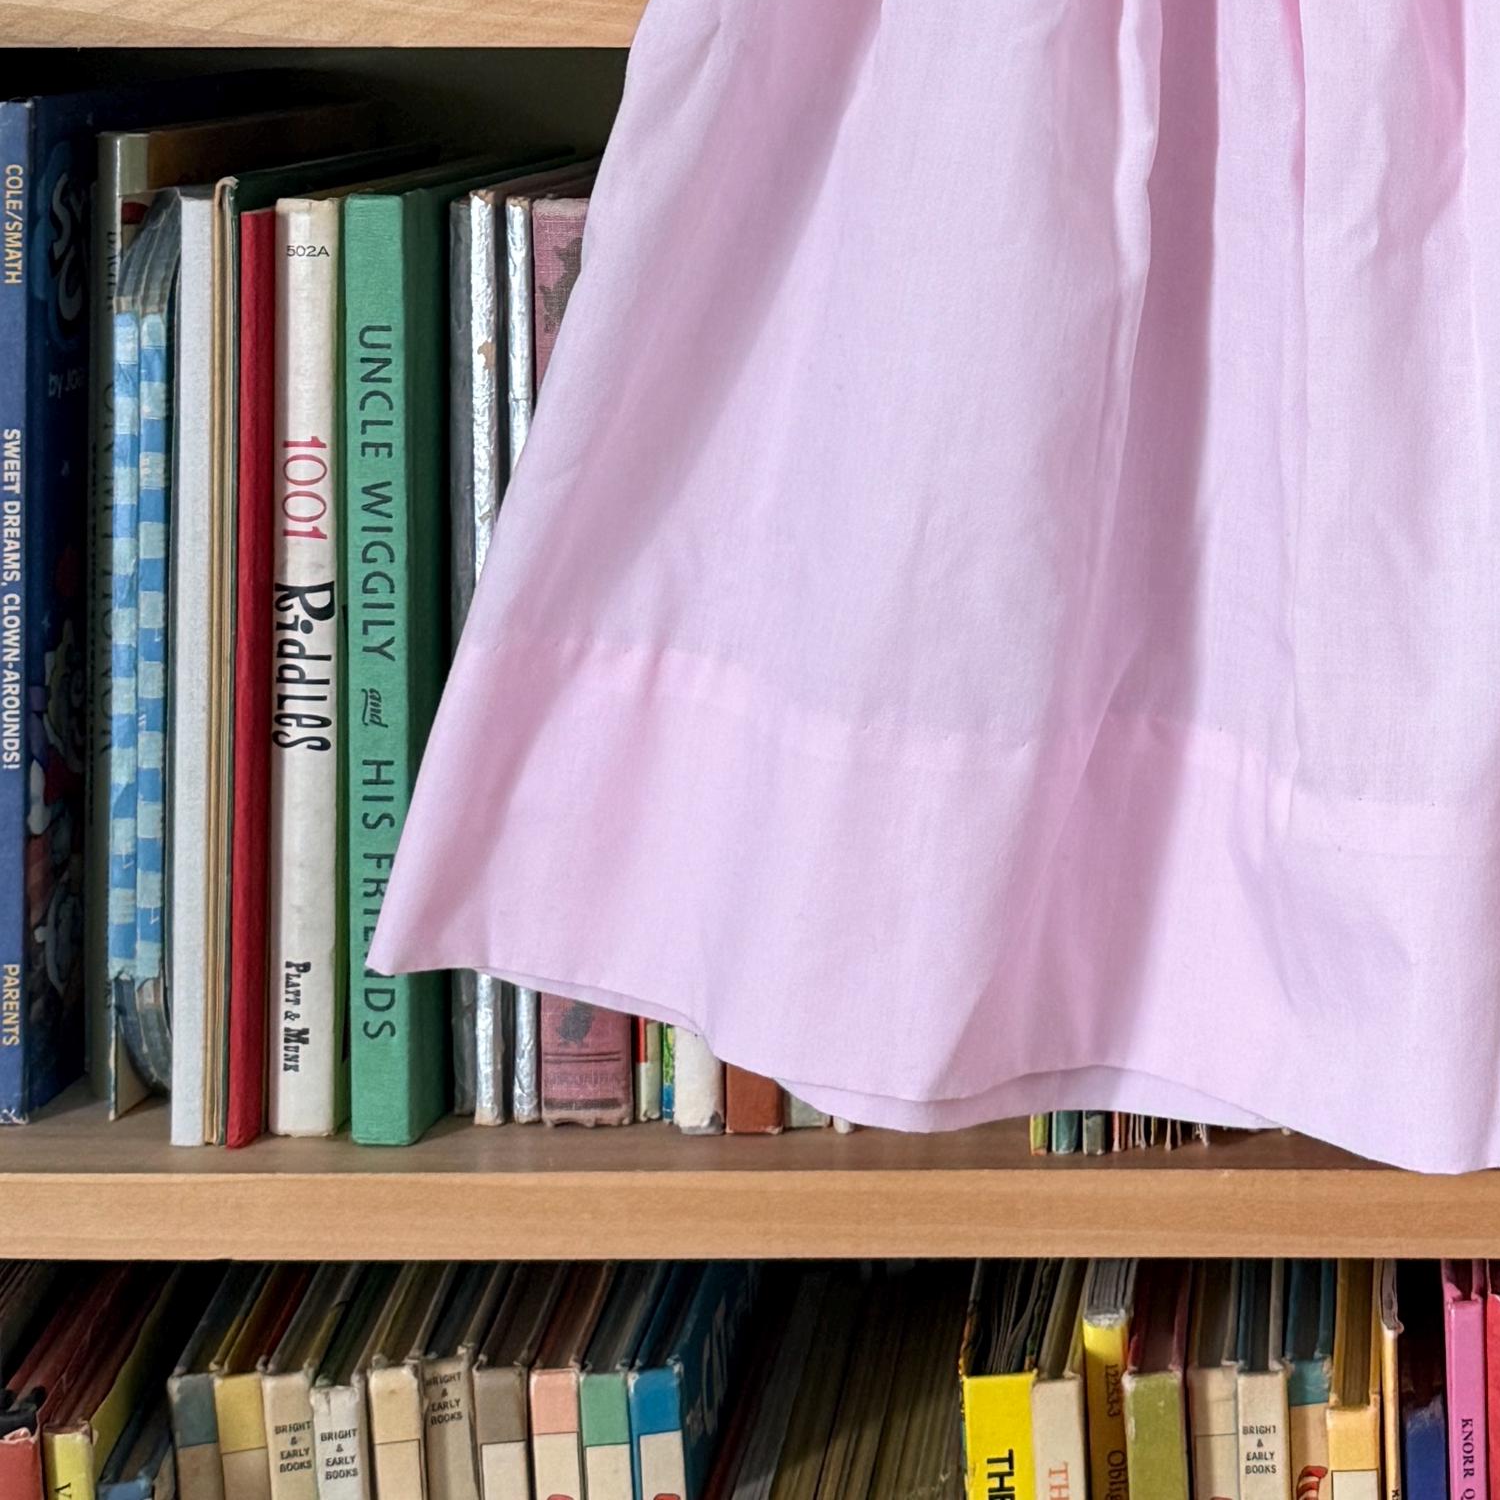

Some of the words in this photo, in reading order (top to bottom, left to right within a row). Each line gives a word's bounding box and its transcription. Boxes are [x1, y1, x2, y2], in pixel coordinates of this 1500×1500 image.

[4, 164, 24, 284] COLE/SMATH
[286, 245, 330, 257] 502A
[358, 325, 394, 459] UNCLE
[3, 428, 21, 494] SWEET
[281, 436, 328, 540] 1001
[1, 501, 21, 587] DREAMS,
[361, 481, 396, 661] WIGGILY
[361, 688, 389, 728] and
[362, 759, 396, 830] HIS
[2, 964, 20, 1046] PARENTS
[284, 1010, 301, 1023] &
[275, 1421, 312, 1435] BRIGHT
[320, 1428, 357, 1442] BRIGHT
[1242, 1426, 1277, 1436] BRIGHT
[280, 1448, 310, 1460] EARLY
[1461, 1418, 1475, 1479] KNORR
[325, 1456, 356, 1468] EARLY
[1246, 1452, 1275, 1462] EARLY
[279, 1461, 312, 1473] BOOKS
[1245, 1464, 1277, 1475] BOOKS
[325, 1468, 358, 1481] BOOKS
